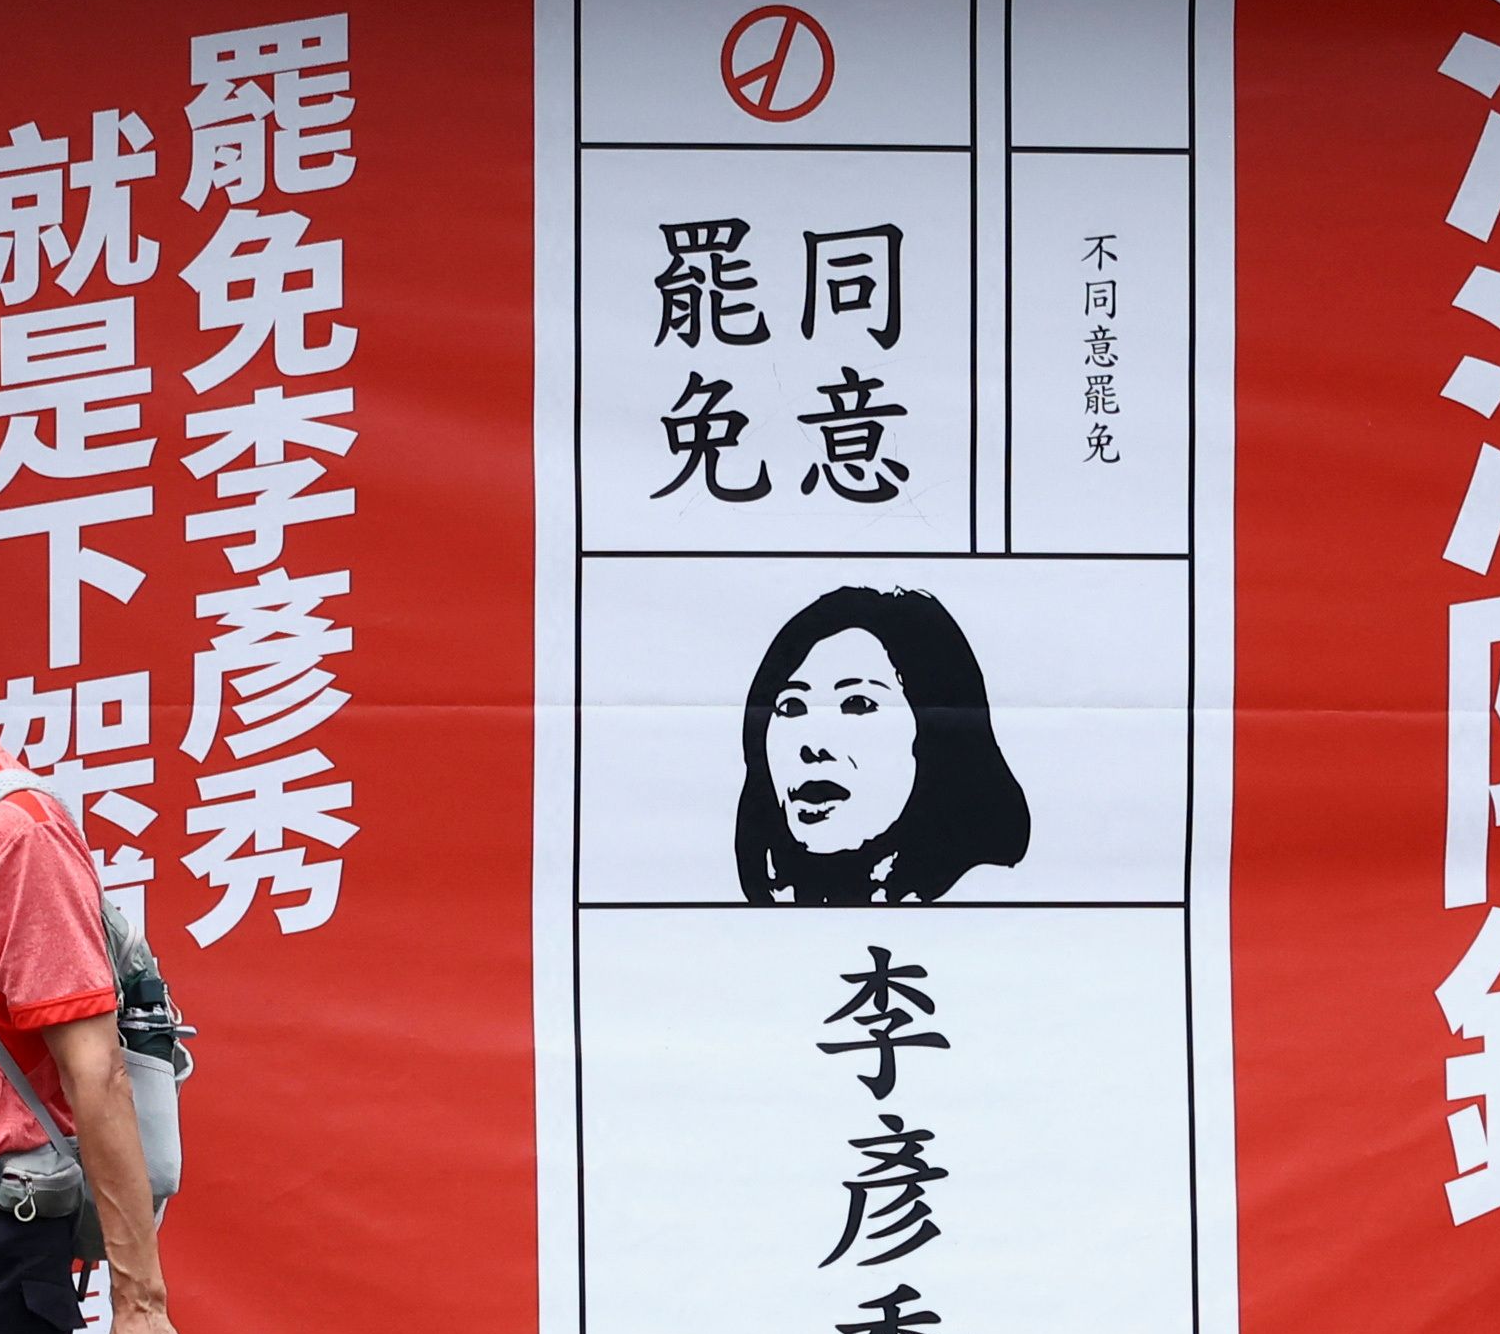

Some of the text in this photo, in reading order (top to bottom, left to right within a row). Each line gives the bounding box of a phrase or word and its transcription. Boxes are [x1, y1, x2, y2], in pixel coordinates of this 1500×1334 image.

[180, 12, 361, 950] 罷免李彥秀
[649, 217, 774, 505] 罷免
[799, 222, 911, 504] 同意
[1081, 233, 1122, 467] 不同意罷免
